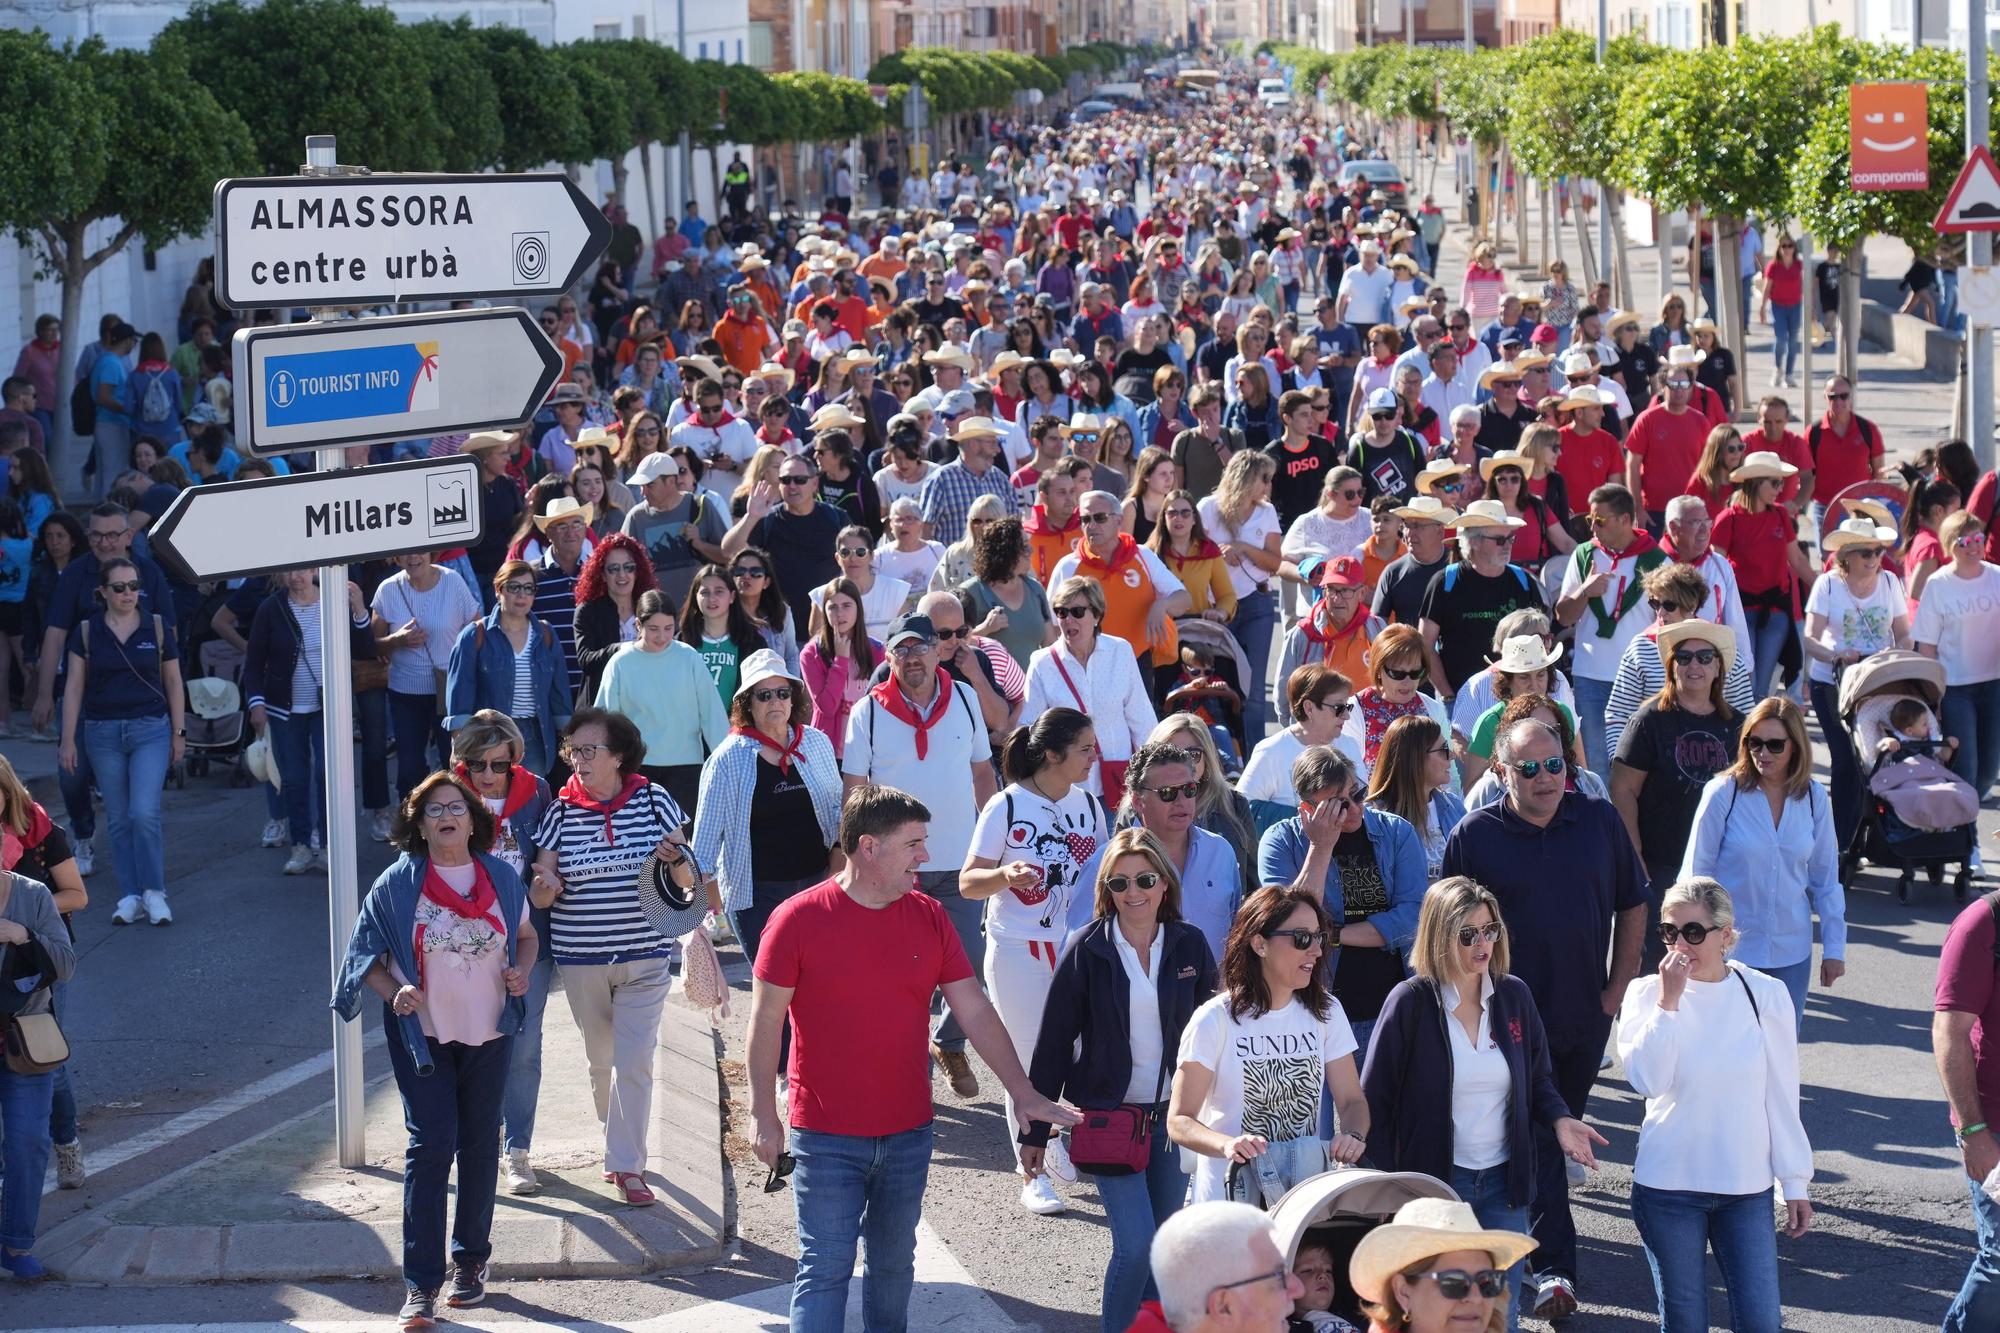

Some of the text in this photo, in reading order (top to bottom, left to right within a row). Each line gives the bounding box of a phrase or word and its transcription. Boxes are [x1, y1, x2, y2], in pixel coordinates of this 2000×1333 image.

[1854, 169, 1927, 186] compromis
[250, 195, 473, 230] ALMASSORA
[251, 246, 458, 286] centre urbà
[299, 373, 362, 397] TOURIST
[365, 369, 400, 390] INFO
[305, 500, 413, 538] Millars
[1676, 736, 1728, 769] ROCK
[580, 867, 605, 876] YOUR
[607, 864, 630, 873] OWN
